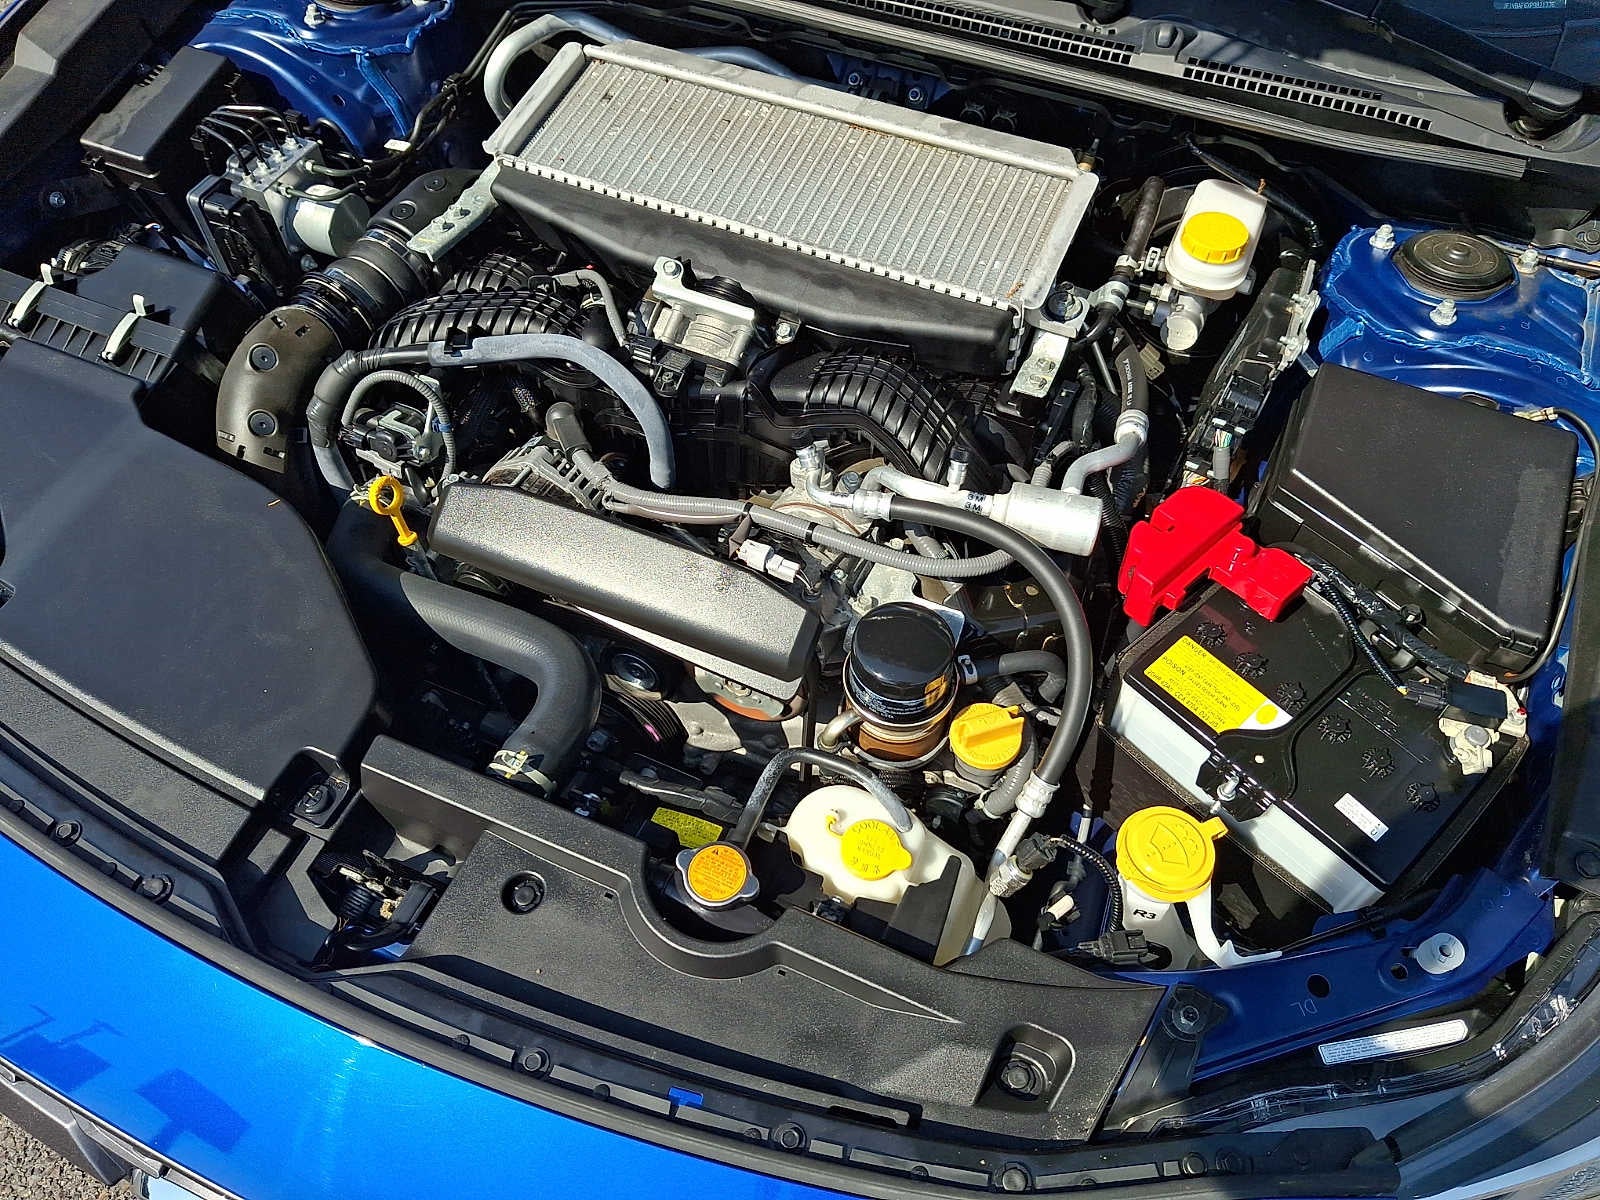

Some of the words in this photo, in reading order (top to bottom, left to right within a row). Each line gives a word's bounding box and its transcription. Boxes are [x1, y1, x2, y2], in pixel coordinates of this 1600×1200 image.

[1182, 637, 1207, 659] DANGER
[1162, 655, 1186, 676] POISON
[1133, 909, 1156, 919] R3
[1290, 999, 1317, 1016] DL
